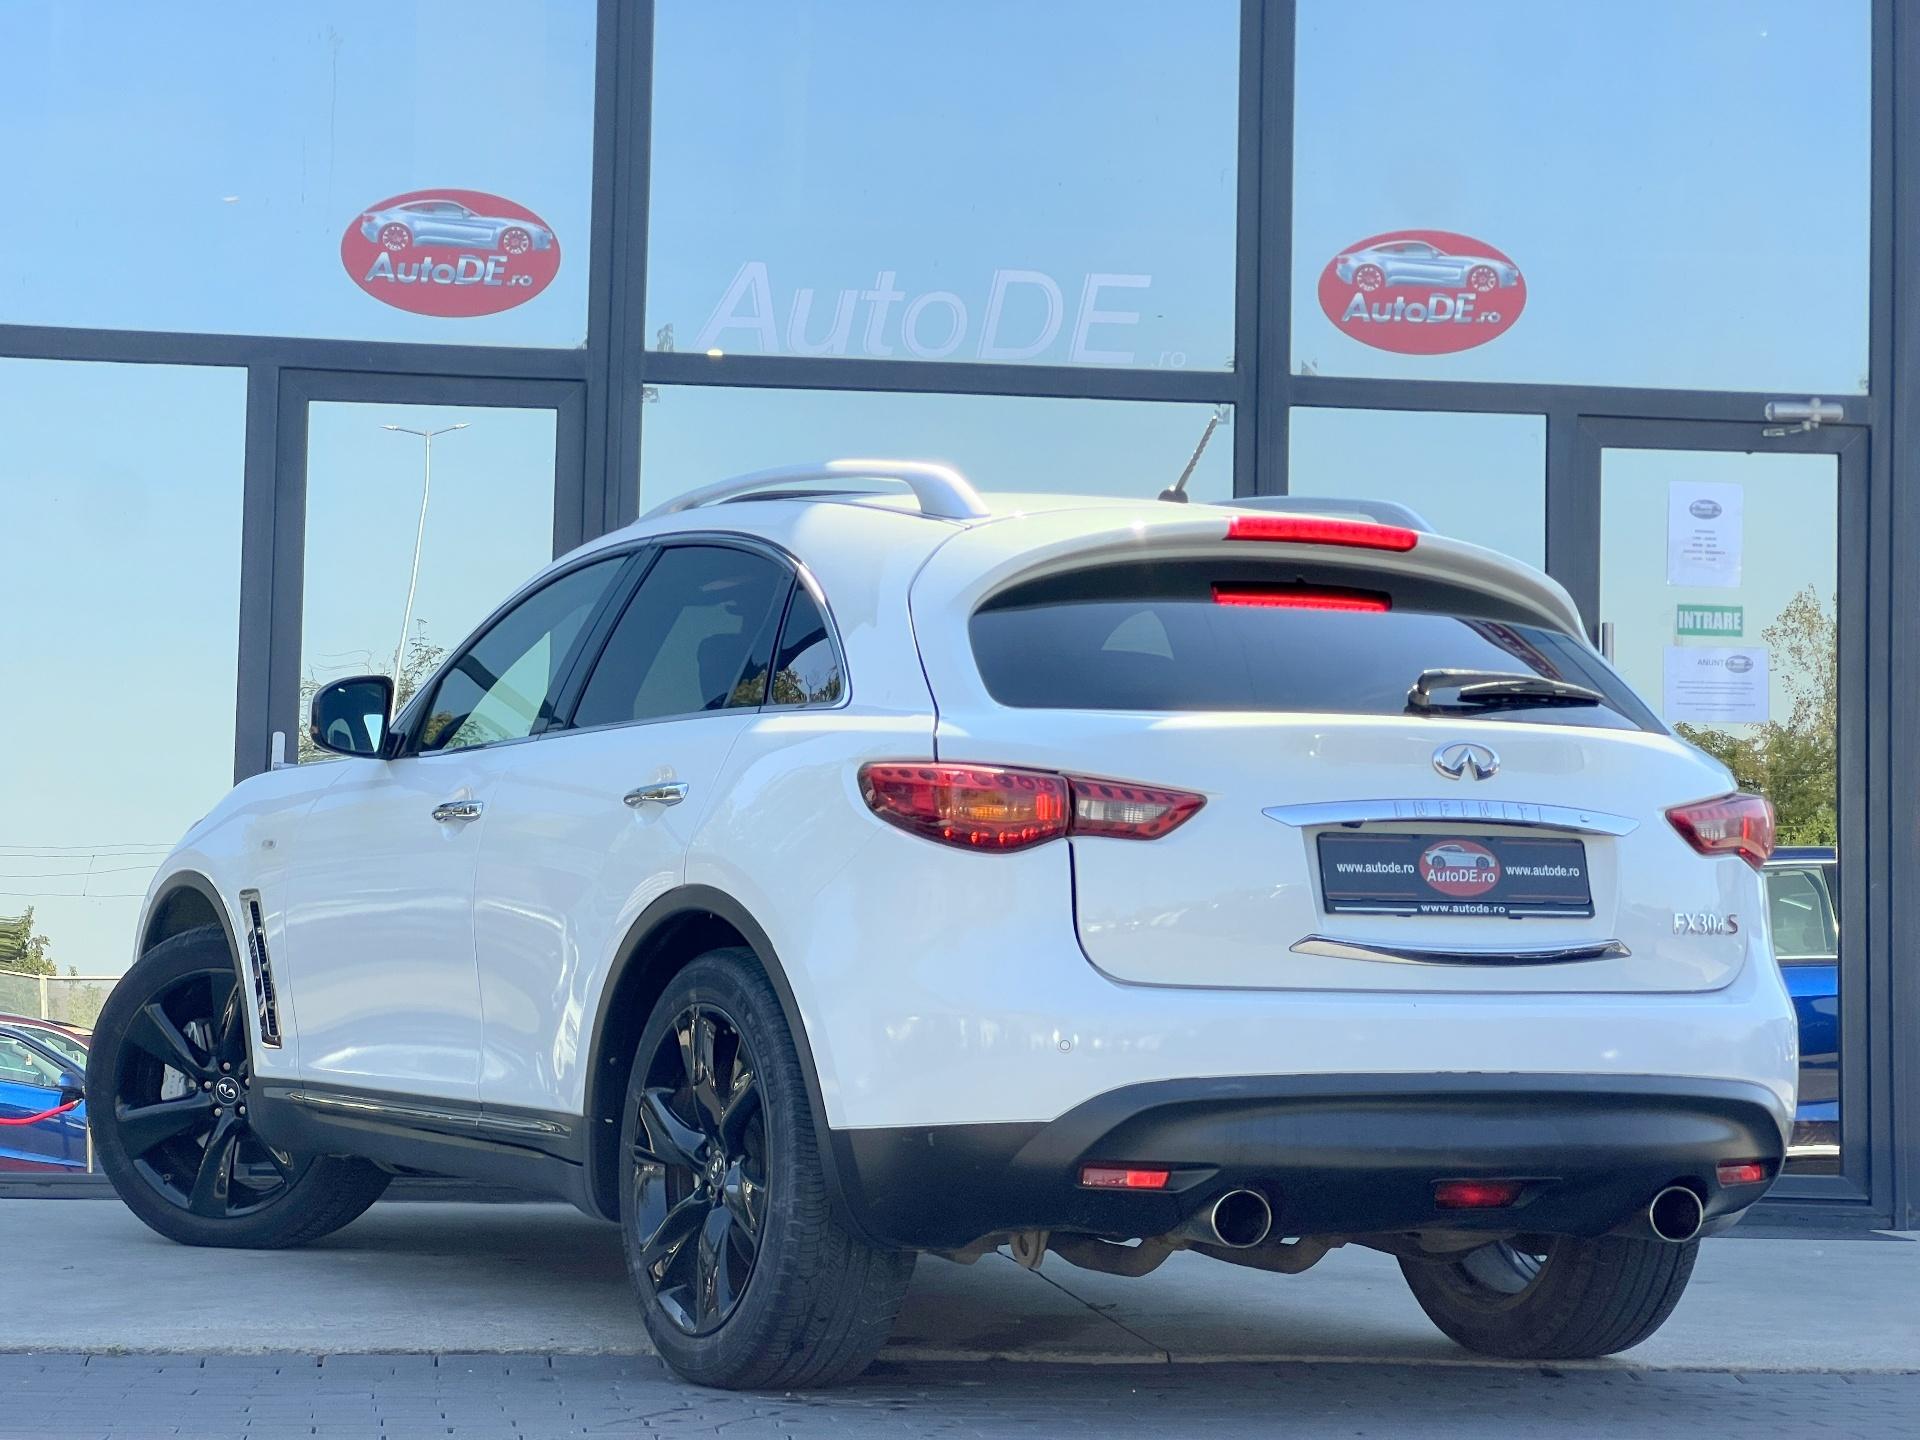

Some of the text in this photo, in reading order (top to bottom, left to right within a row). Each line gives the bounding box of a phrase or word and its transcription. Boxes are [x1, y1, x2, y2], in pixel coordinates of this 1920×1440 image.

[1677, 610, 1742, 632] INTRARE
[1393, 800, 1546, 822] INFINITI
[1336, 861, 1415, 875] www.autode.ro
[1505, 864, 1580, 878] www.autode.ro
[1426, 868, 1496, 884] AutoDE.ro
[1420, 903, 1506, 914] www.autode.ro
